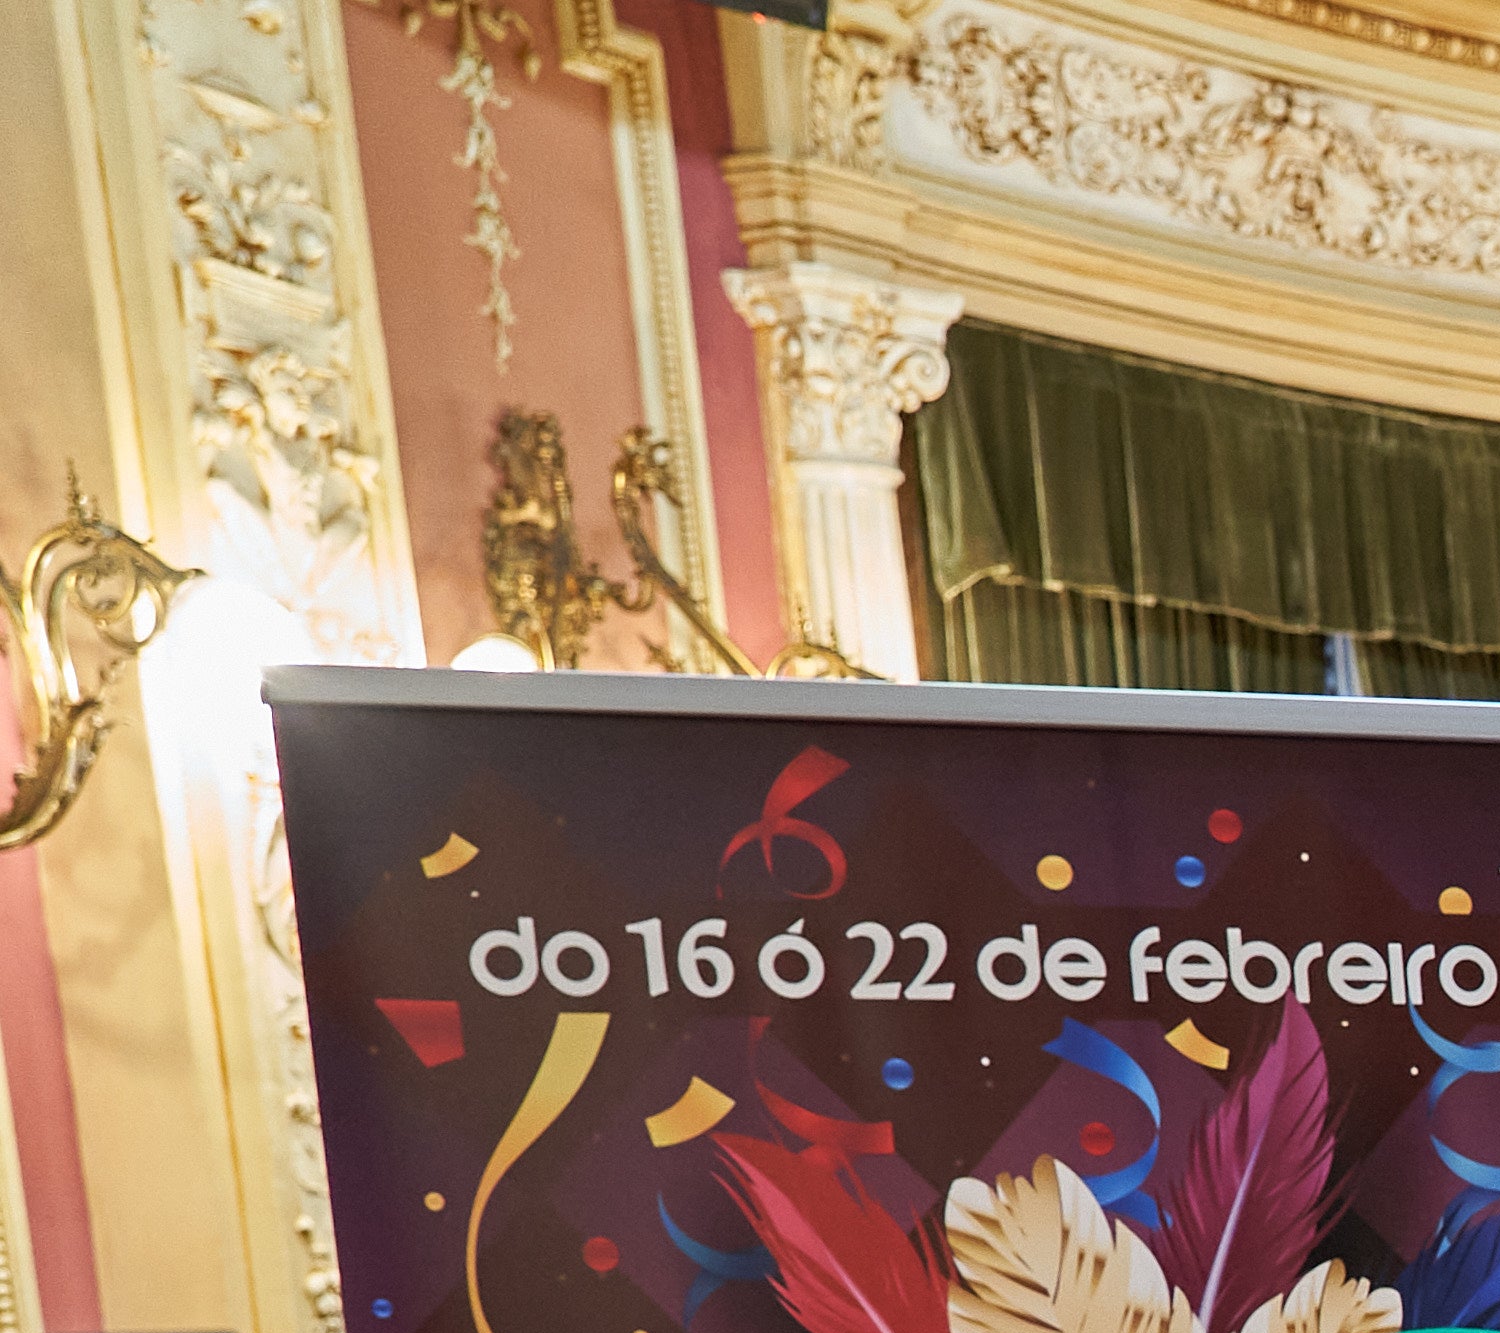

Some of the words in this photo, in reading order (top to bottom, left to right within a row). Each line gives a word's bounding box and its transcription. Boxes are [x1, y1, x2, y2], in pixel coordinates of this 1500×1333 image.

[469, 916, 611, 998] do
[625, 917, 735, 999] 16
[846, 921, 956, 1000] 22
[976, 924, 1107, 1002] de
[1129, 926, 1498, 1007] febreiro
